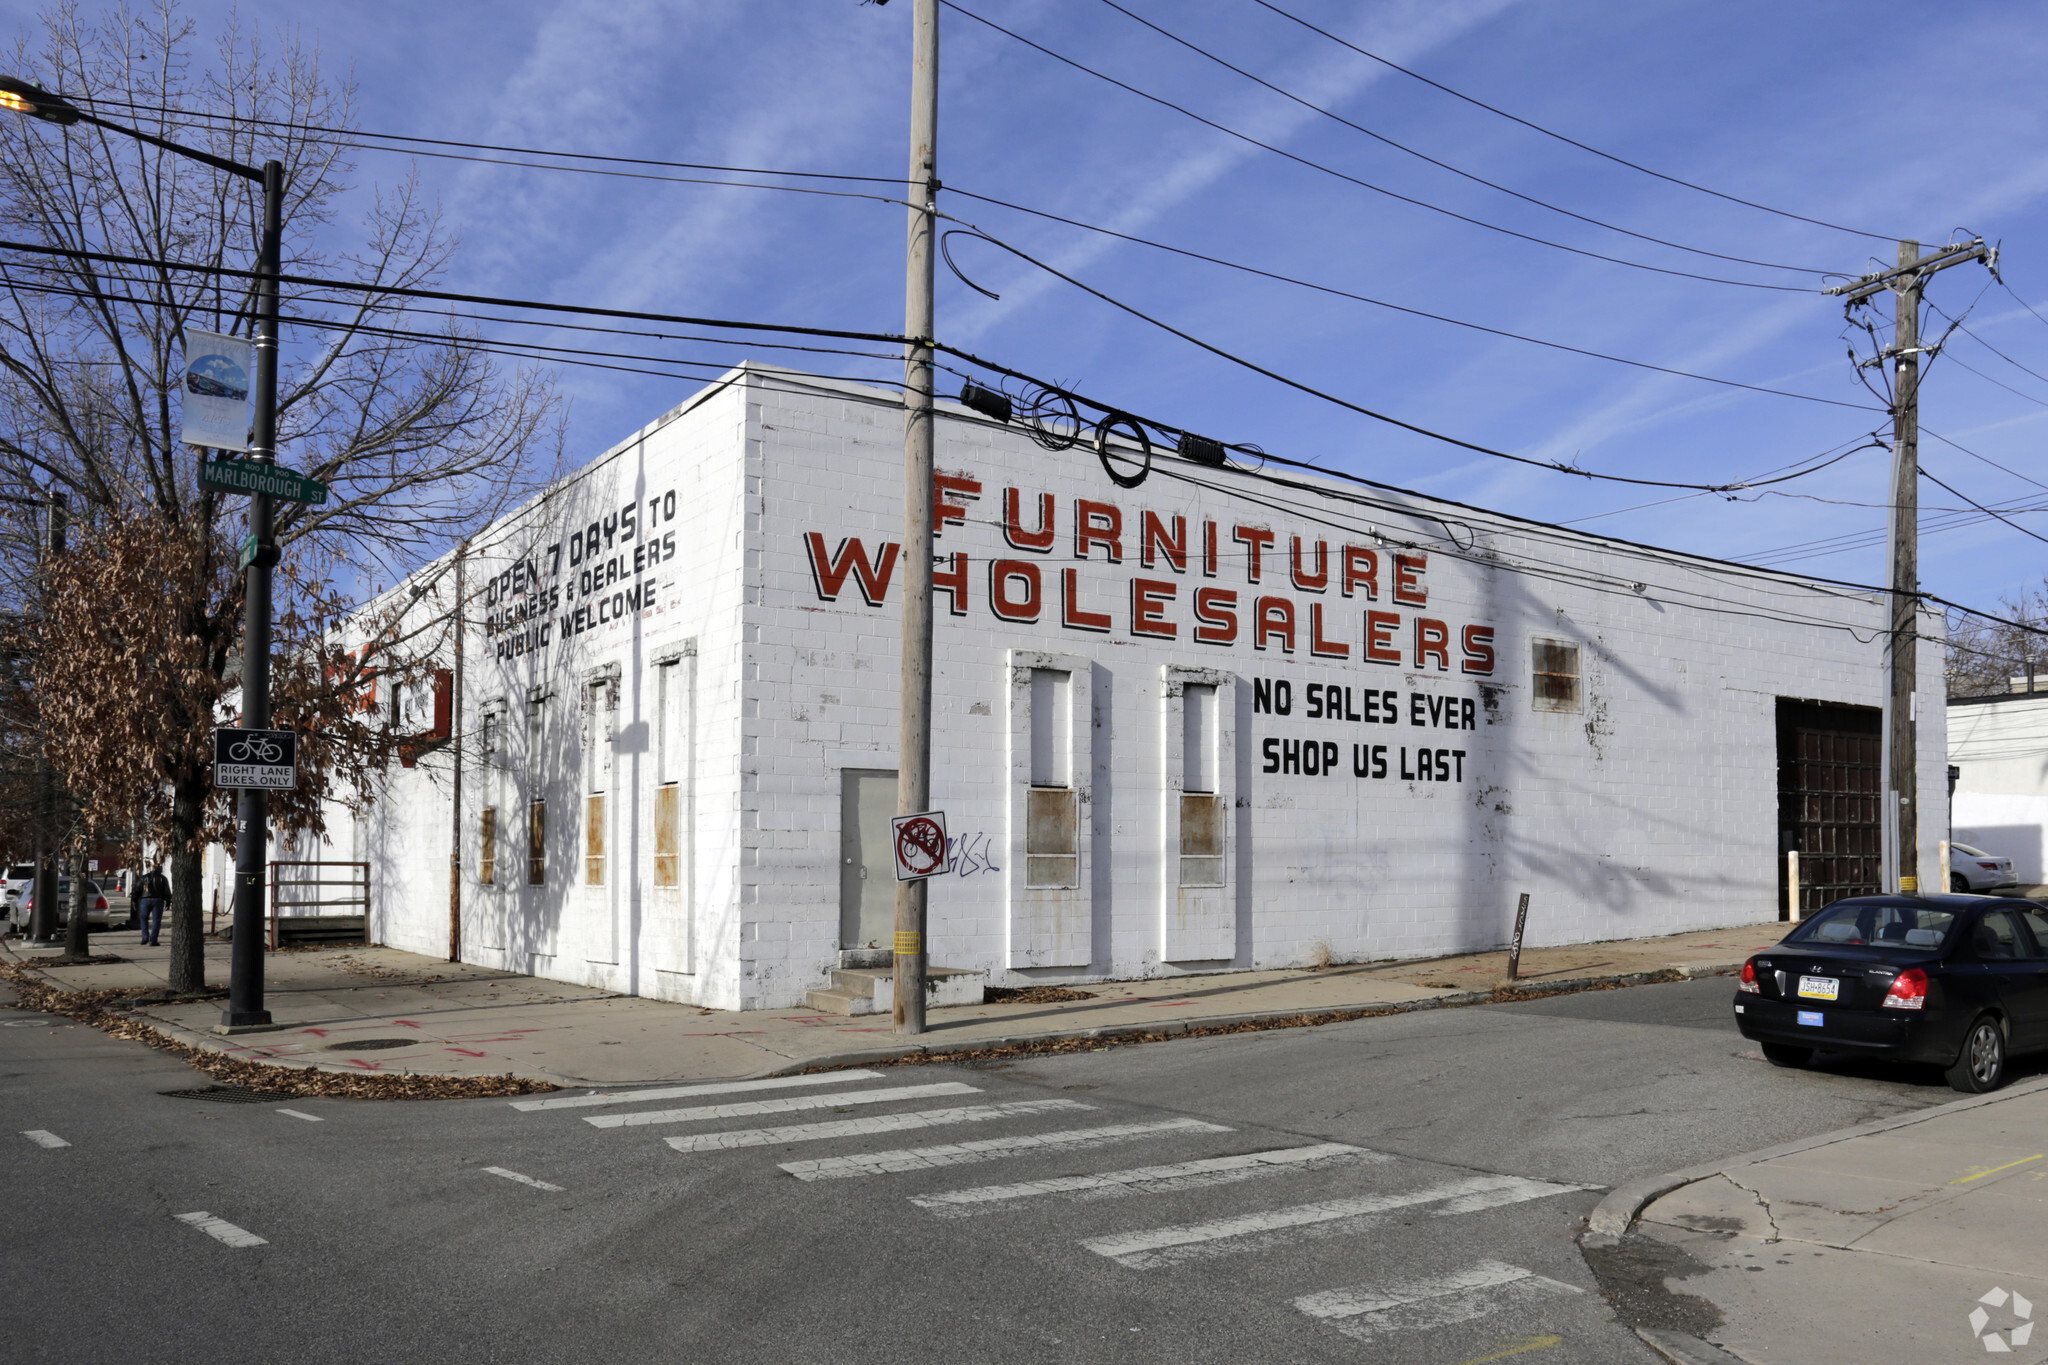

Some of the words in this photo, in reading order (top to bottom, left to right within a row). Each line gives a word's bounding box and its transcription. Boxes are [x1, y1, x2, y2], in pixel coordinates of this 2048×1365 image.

[204, 463, 302, 499] MARLBOROUGH
[311, 490, 324, 503] ST
[244, 463, 260, 472] 800
[274, 469, 290, 478] 900
[487, 553, 539, 608] OPEN
[547, 542, 560, 577] 7
[569, 501, 637, 569] DAYS
[648, 488, 676, 529] TO
[933, 468, 1429, 609] FURNITURE
[487, 585, 560, 638] BUSINESS
[581, 529, 676, 597] DEALERS
[803, 531, 1495, 677] WHOLESALERS
[496, 622, 551, 665] PUBLIC
[560, 577, 657, 639] WELCOME
[1253, 677, 1292, 716] NO
[1306, 682, 1399, 725] SALES
[1410, 692, 1476, 731] EVER
[220, 765, 257, 776] RIGHT
[260, 767, 291, 776] LANE
[221, 775, 255, 785] BIKES
[260, 776, 290, 786] ONLY
[1262, 737, 1339, 777] SHOP
[1353, 743, 1388, 779] US
[1400, 746, 1467, 783] LAST
